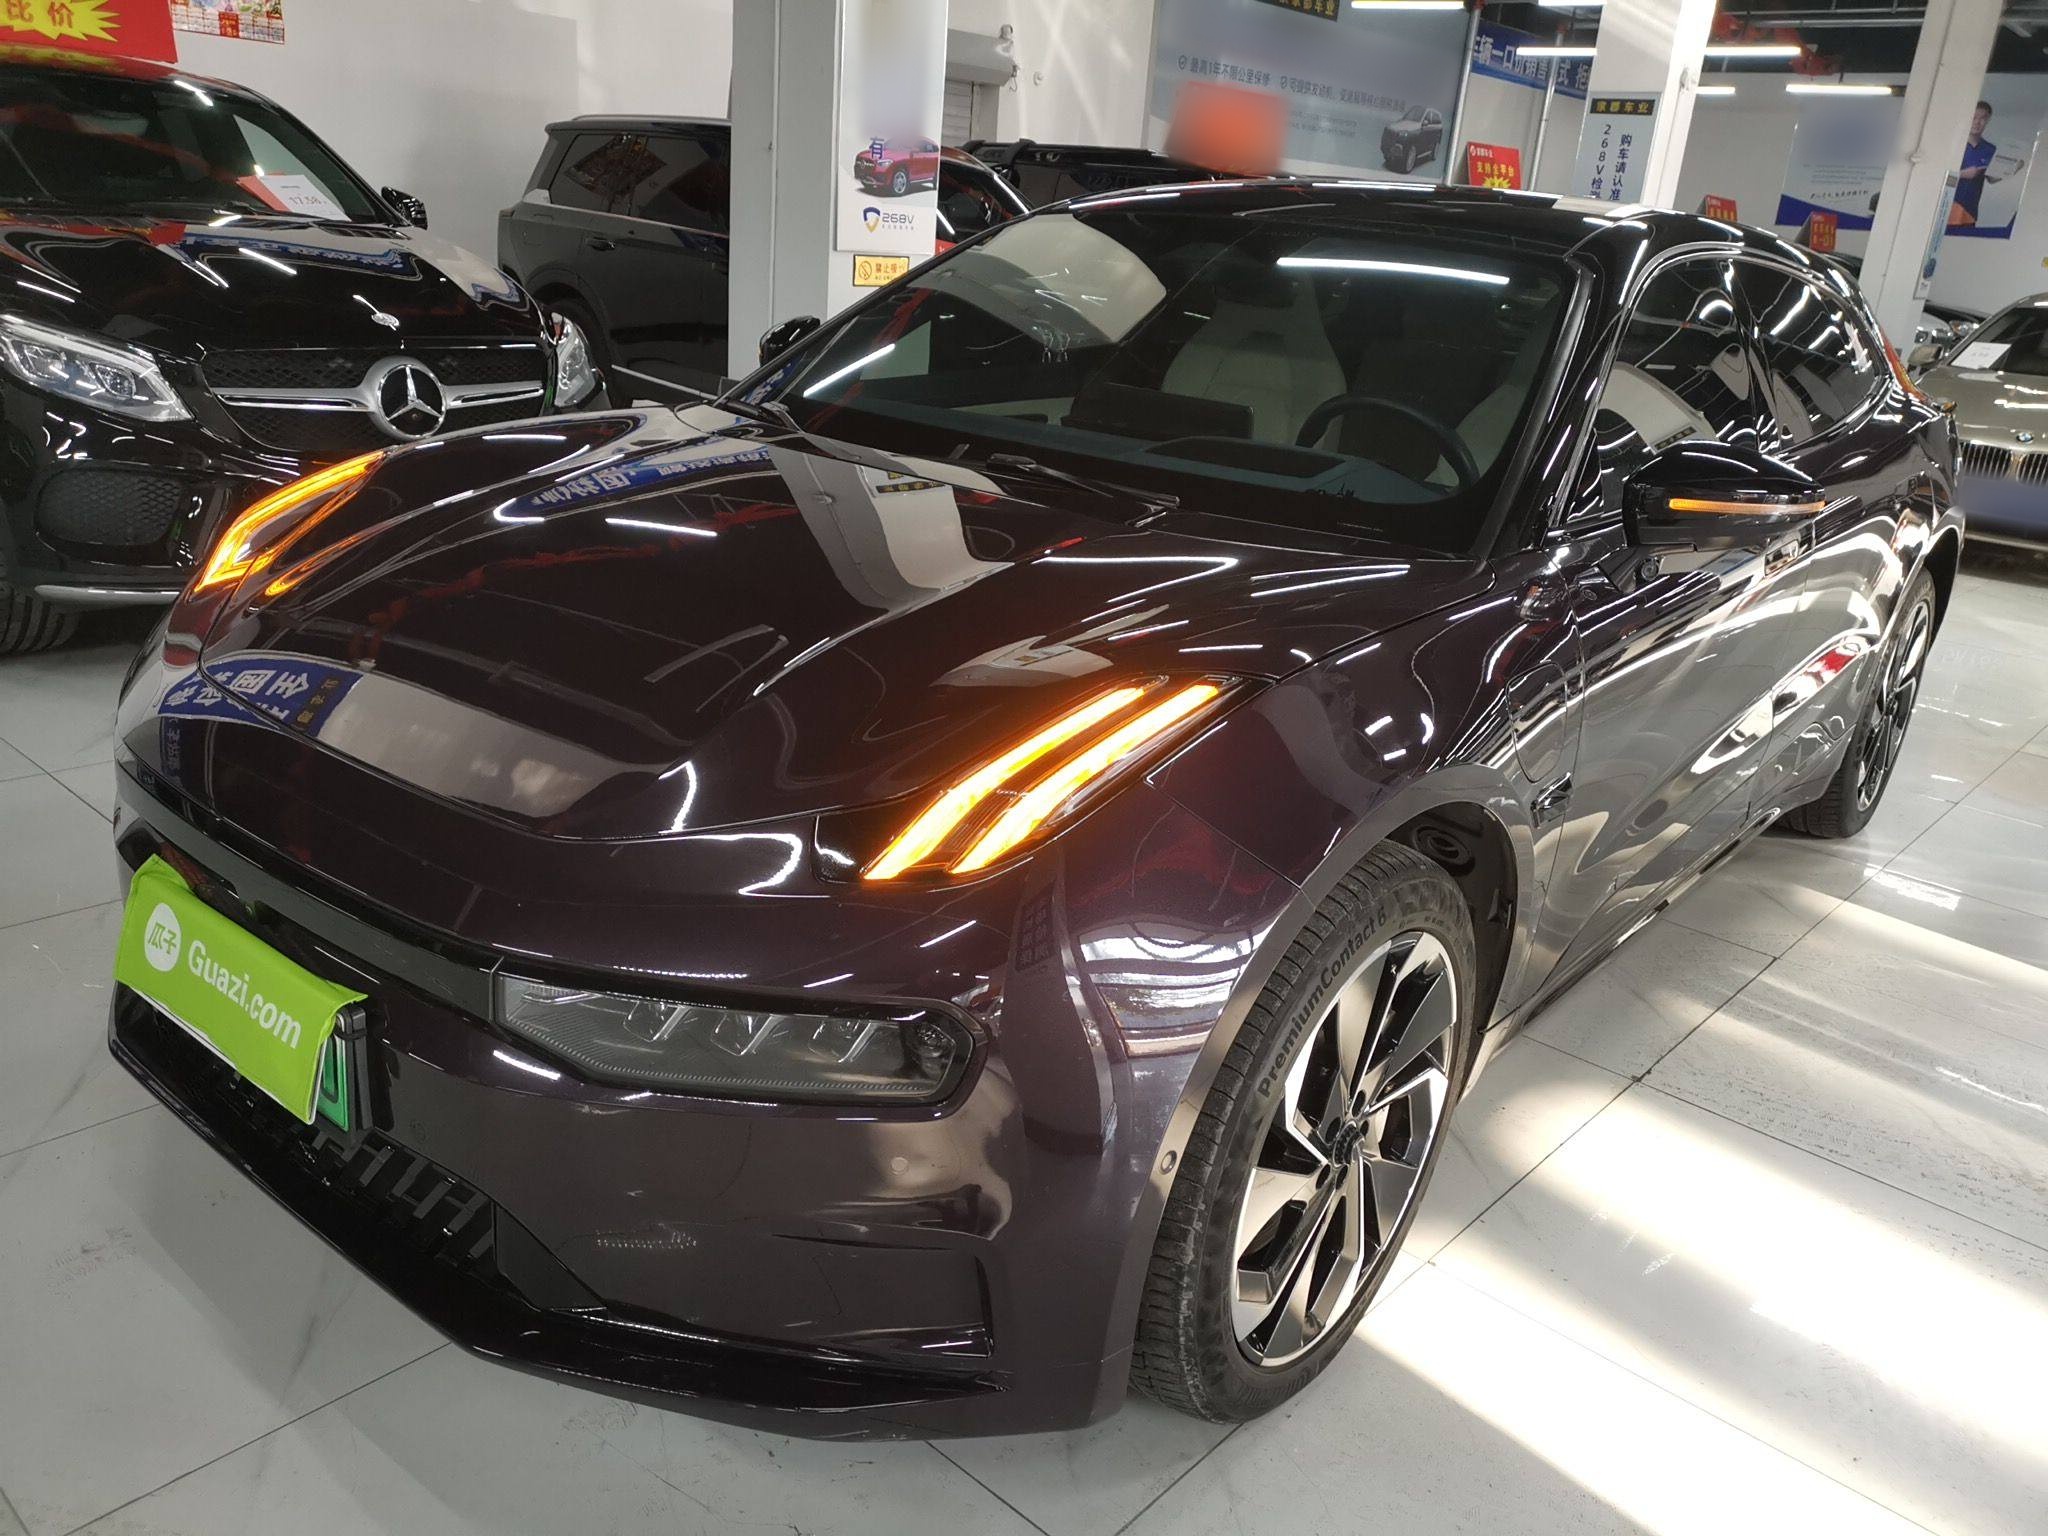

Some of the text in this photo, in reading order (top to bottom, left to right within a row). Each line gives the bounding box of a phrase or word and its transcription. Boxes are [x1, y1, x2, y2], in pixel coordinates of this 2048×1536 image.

[6, 1, 73, 28] 比价
[1477, 161, 1515, 177] 支持全平台
[1609, 134, 1633, 200] 购车请认准
[882, 213, 914, 224] 268V
[147, 921, 177, 955] 瓜子
[188, 939, 302, 1050] Guazi.com
[1257, 906, 1386, 1098] PremiumContact 6
